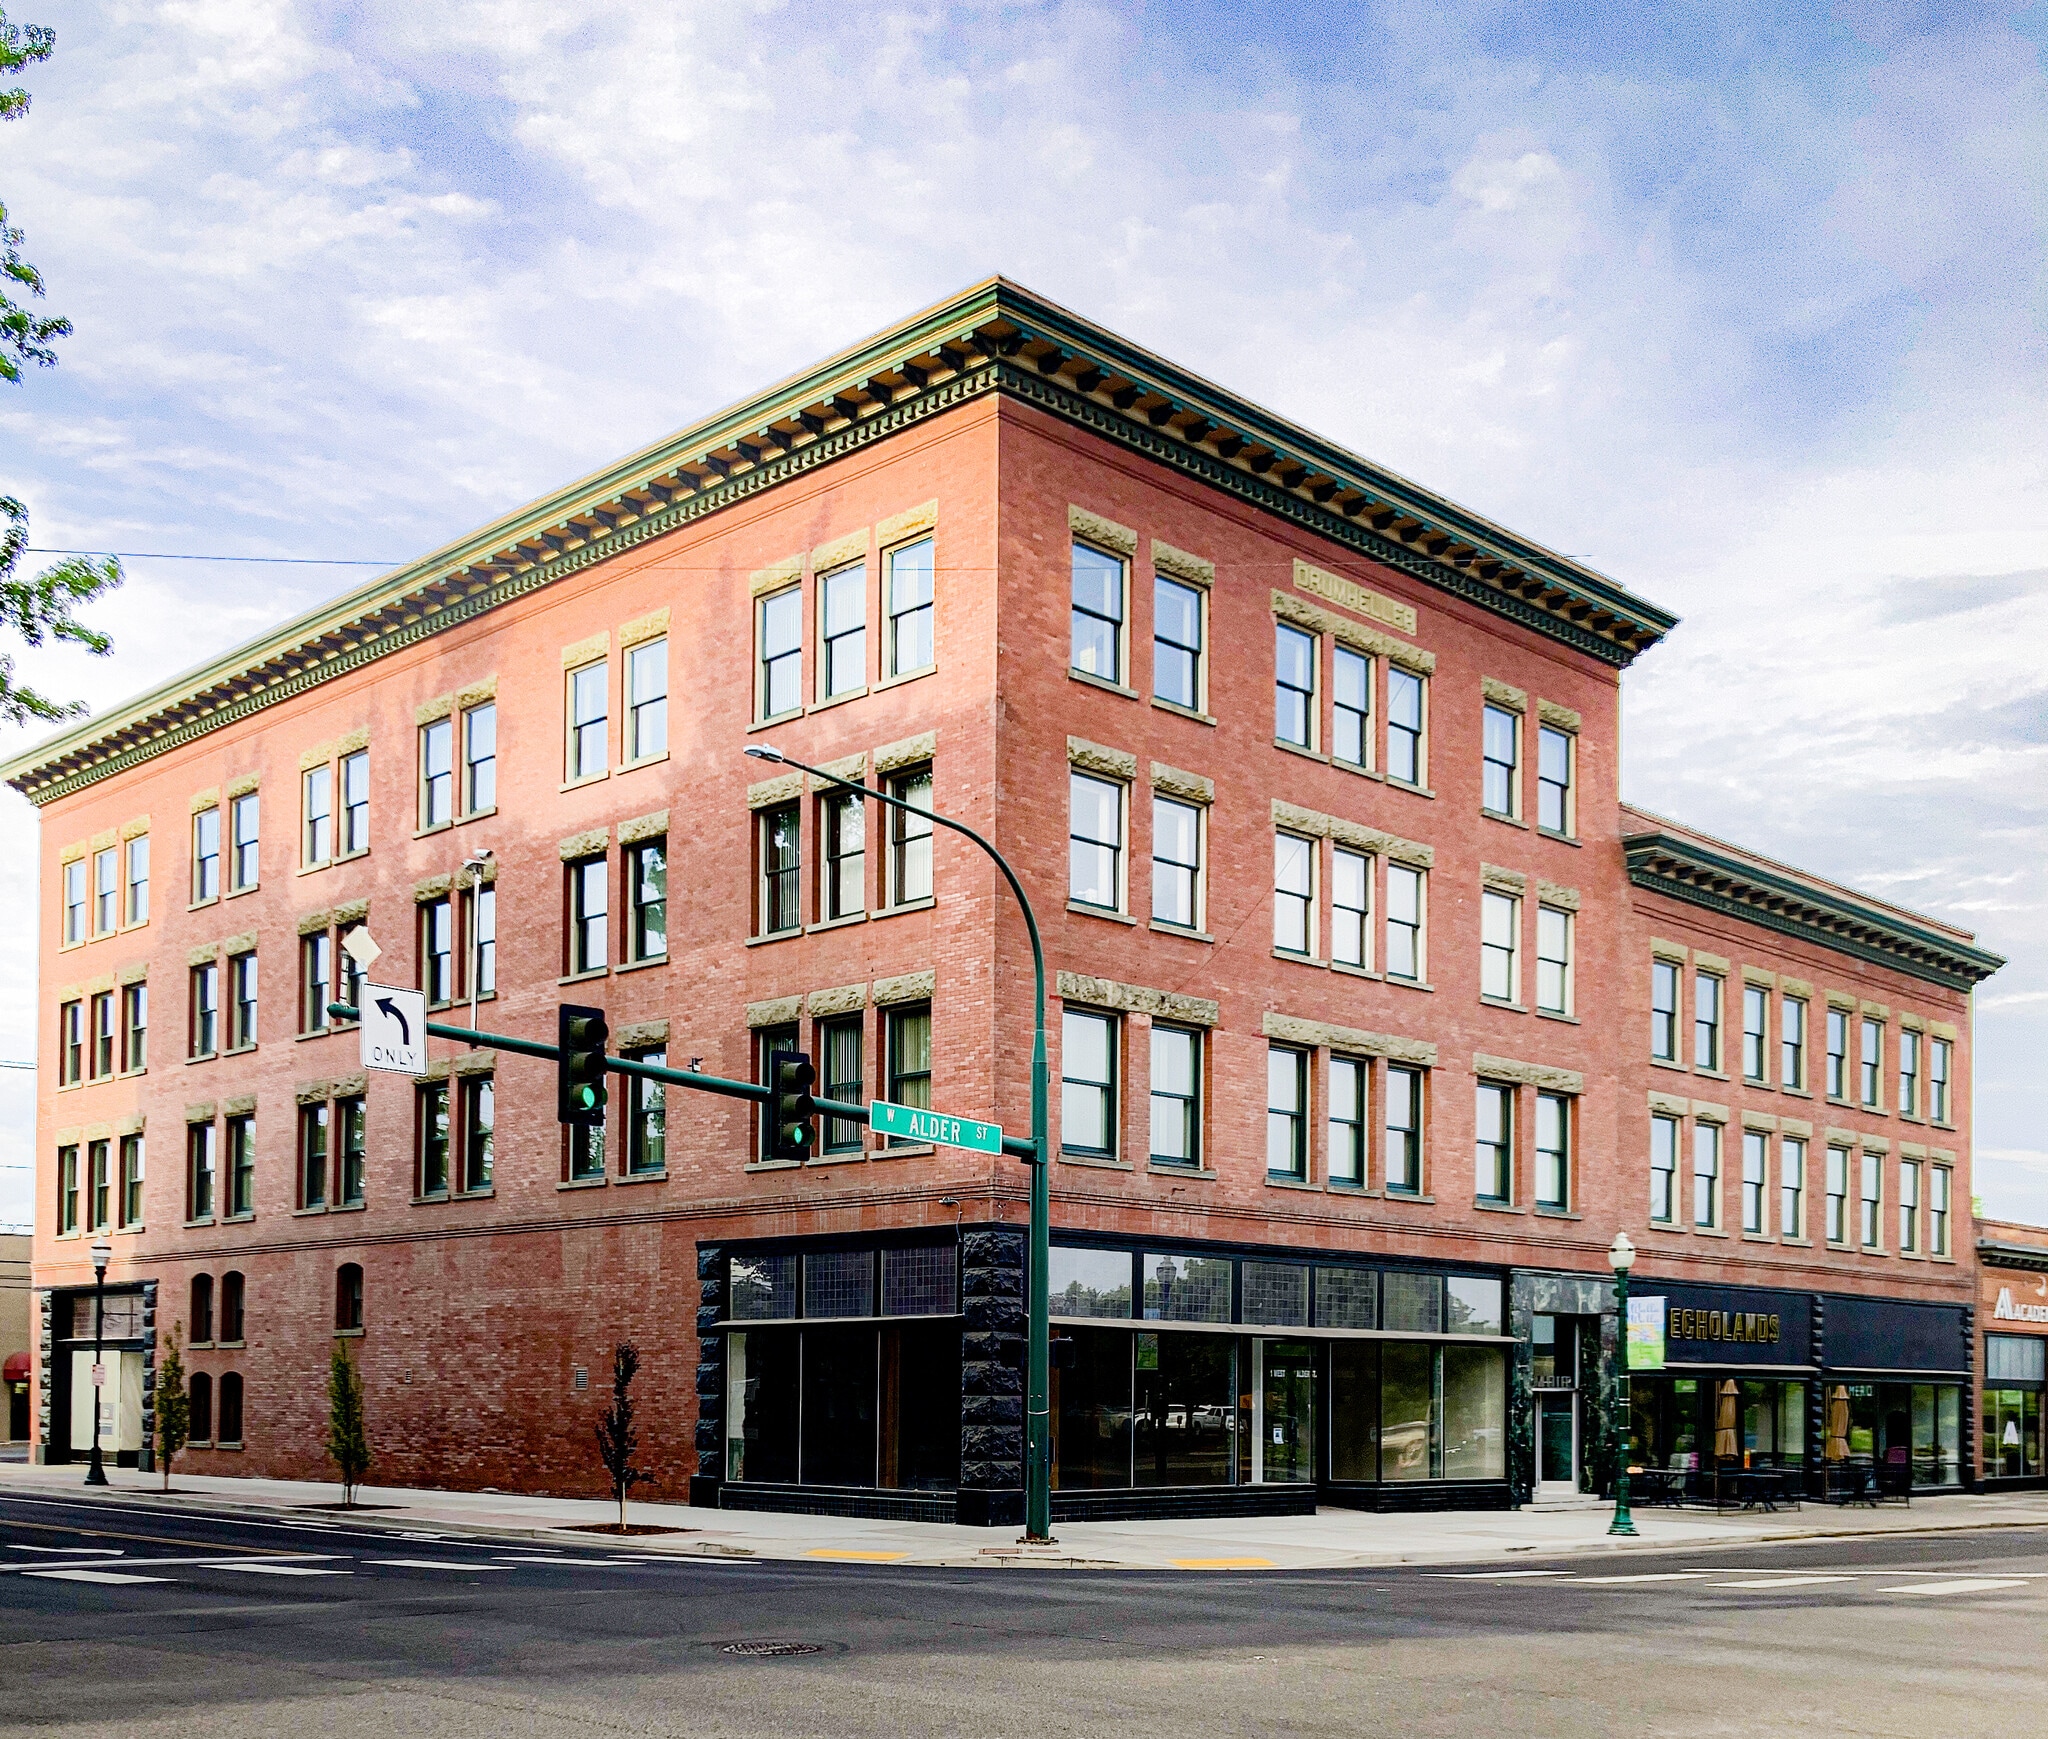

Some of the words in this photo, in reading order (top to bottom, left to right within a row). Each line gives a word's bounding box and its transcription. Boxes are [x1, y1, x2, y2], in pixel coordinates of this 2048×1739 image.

[373, 1046, 417, 1066] ONLY
[886, 1108, 896, 1123] W
[909, 1113, 961, 1143] ALDER
[976, 1125, 988, 1141] ST
[1670, 1307, 1780, 1344] ECHOLANDS
